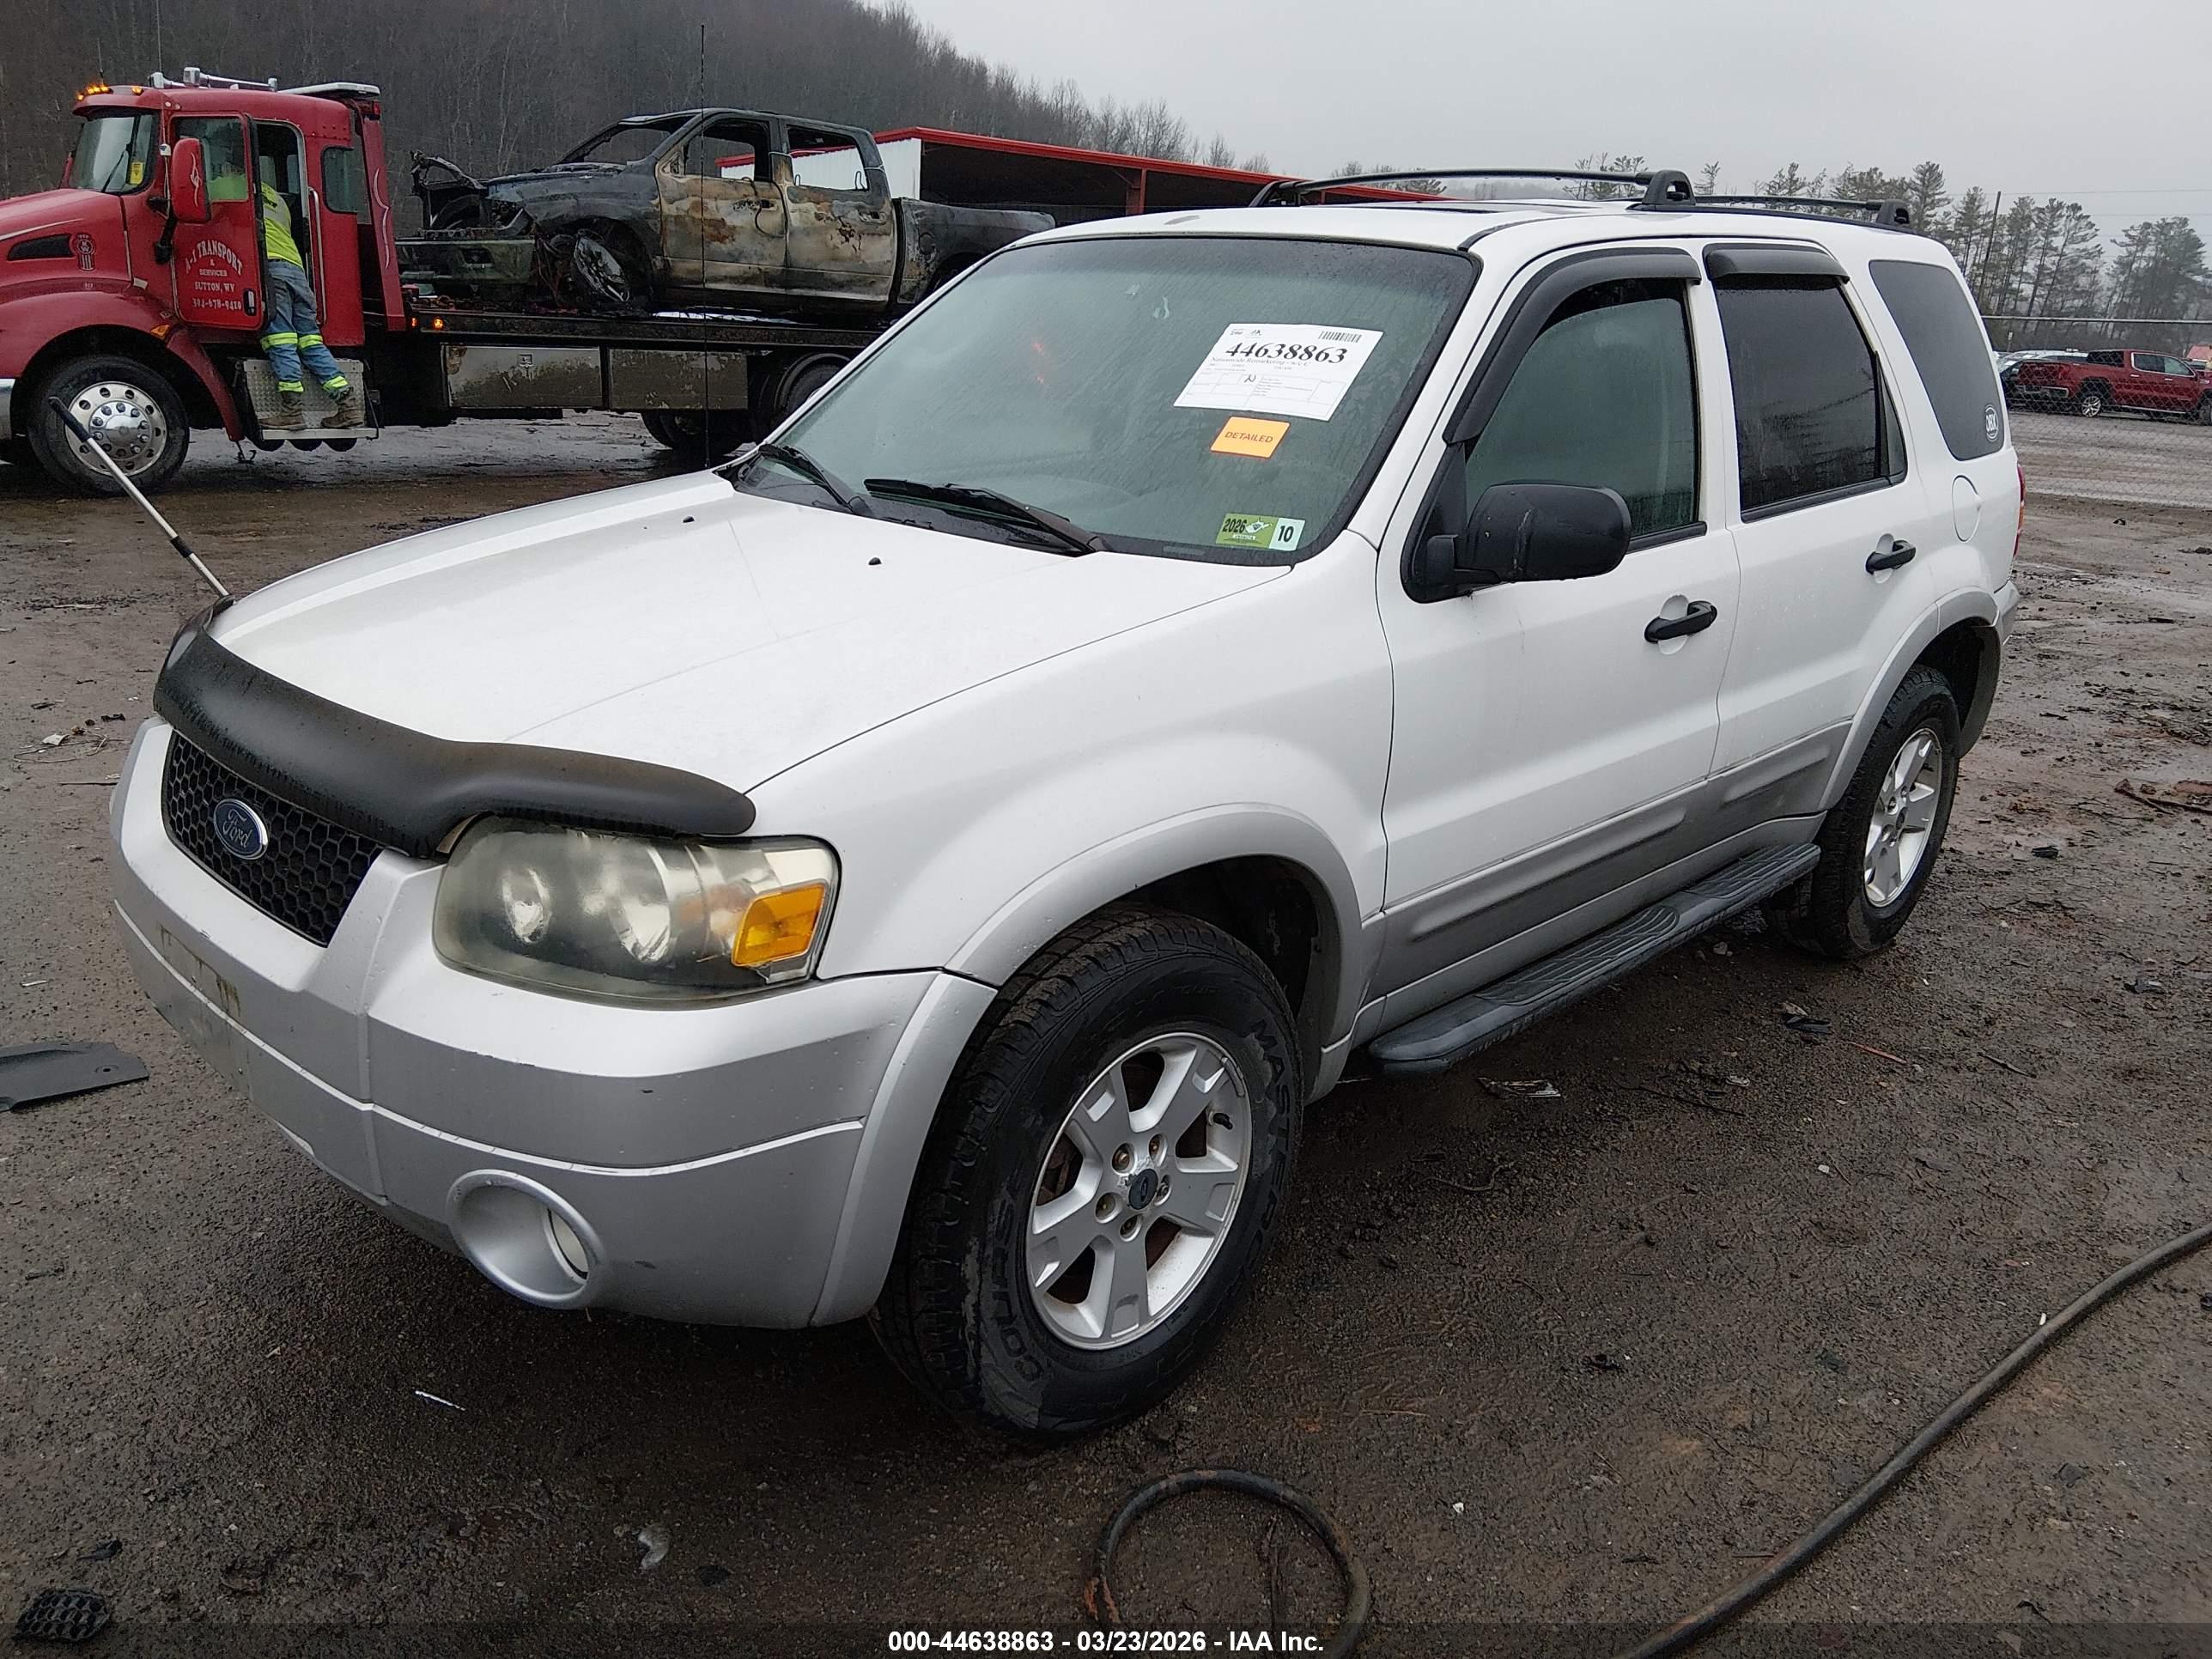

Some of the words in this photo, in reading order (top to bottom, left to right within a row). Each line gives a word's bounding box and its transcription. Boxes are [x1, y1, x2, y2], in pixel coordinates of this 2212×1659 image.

[197, 240, 243, 275] TRANSPORT
[198, 268, 228, 276] SERVICES
[1224, 342, 1347, 364] 44638863
[1224, 431, 1273, 443] DETAILED
[1222, 518, 1248, 533] 2026
[1277, 526, 1294, 543] 10
